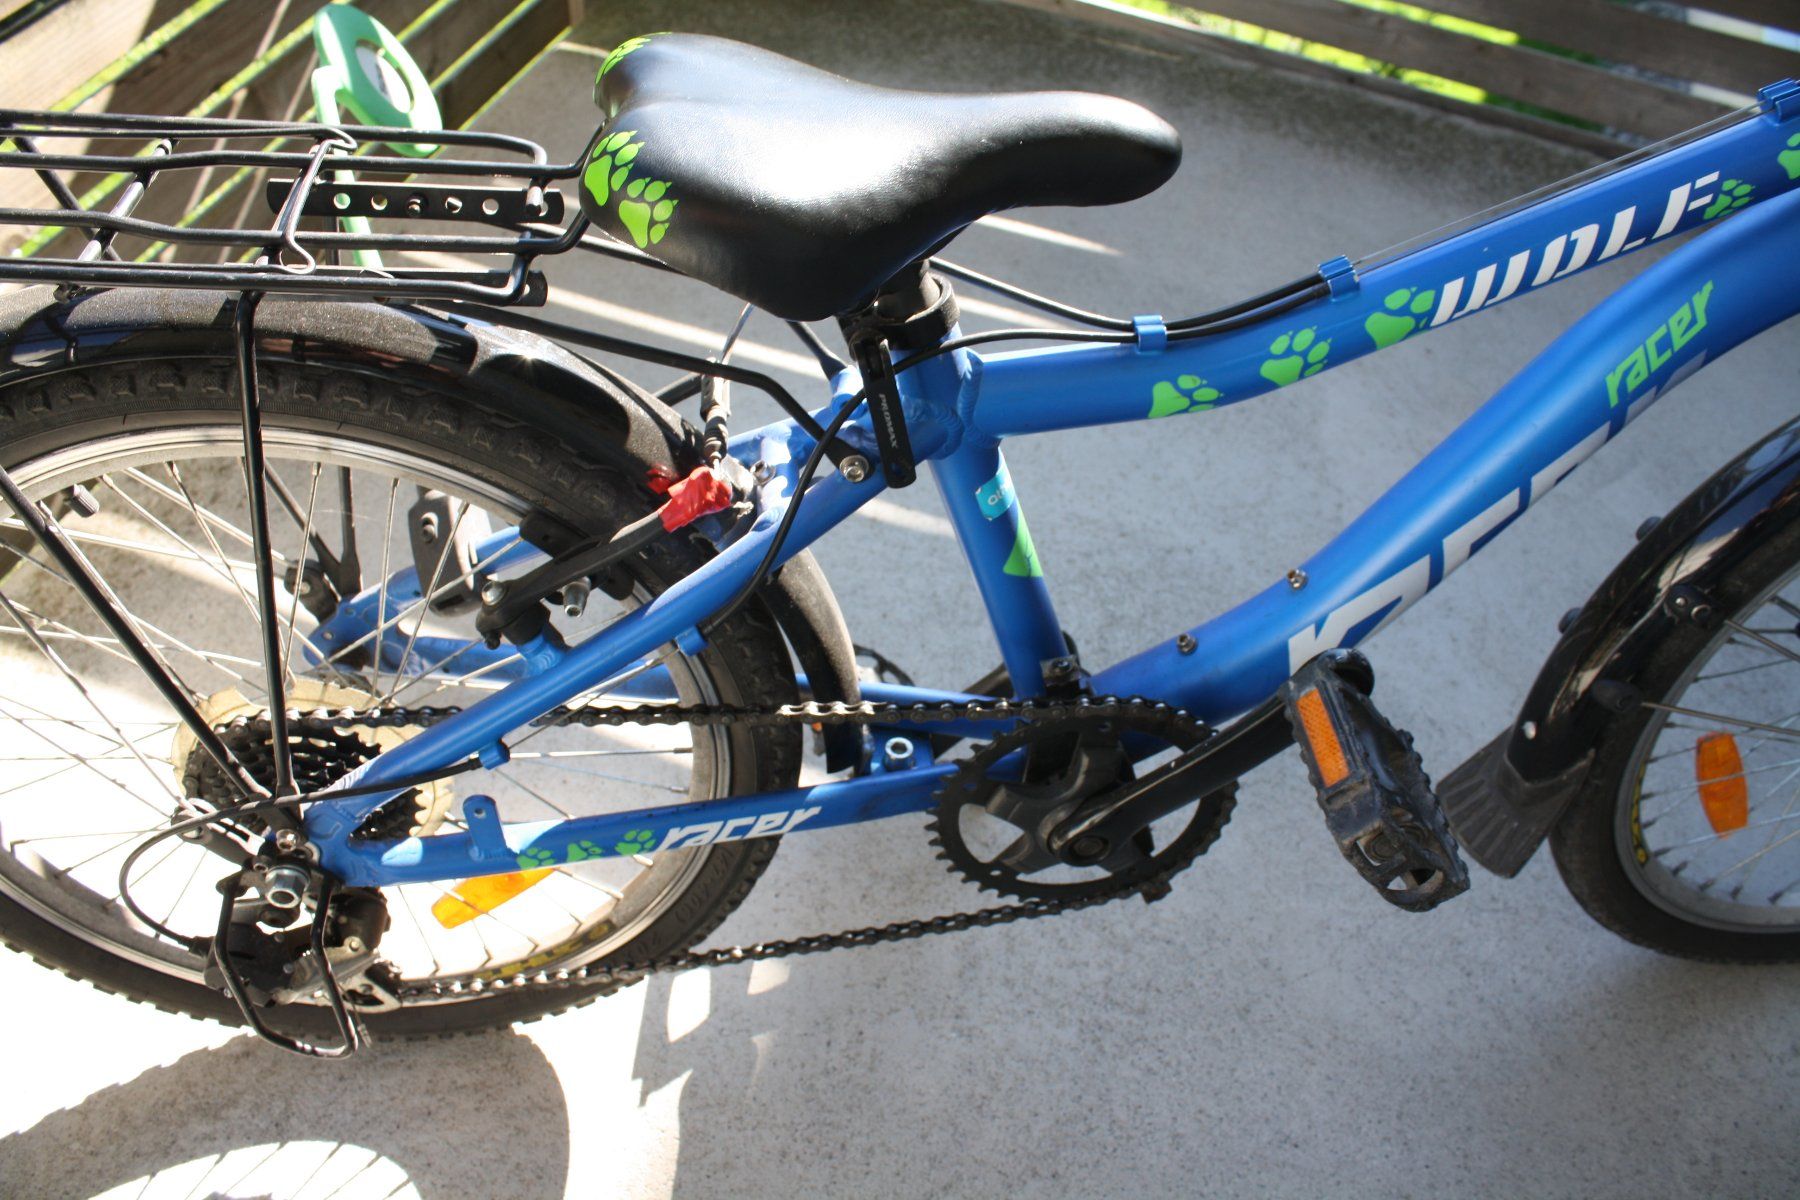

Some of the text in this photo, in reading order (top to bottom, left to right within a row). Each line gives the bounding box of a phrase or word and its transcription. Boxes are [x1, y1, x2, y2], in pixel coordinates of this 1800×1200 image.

[1430, 171, 1720, 327] WOLF
[1605, 280, 1714, 408] racer
[879, 393, 898, 449] PROMAX
[653, 805, 822, 853] racer
